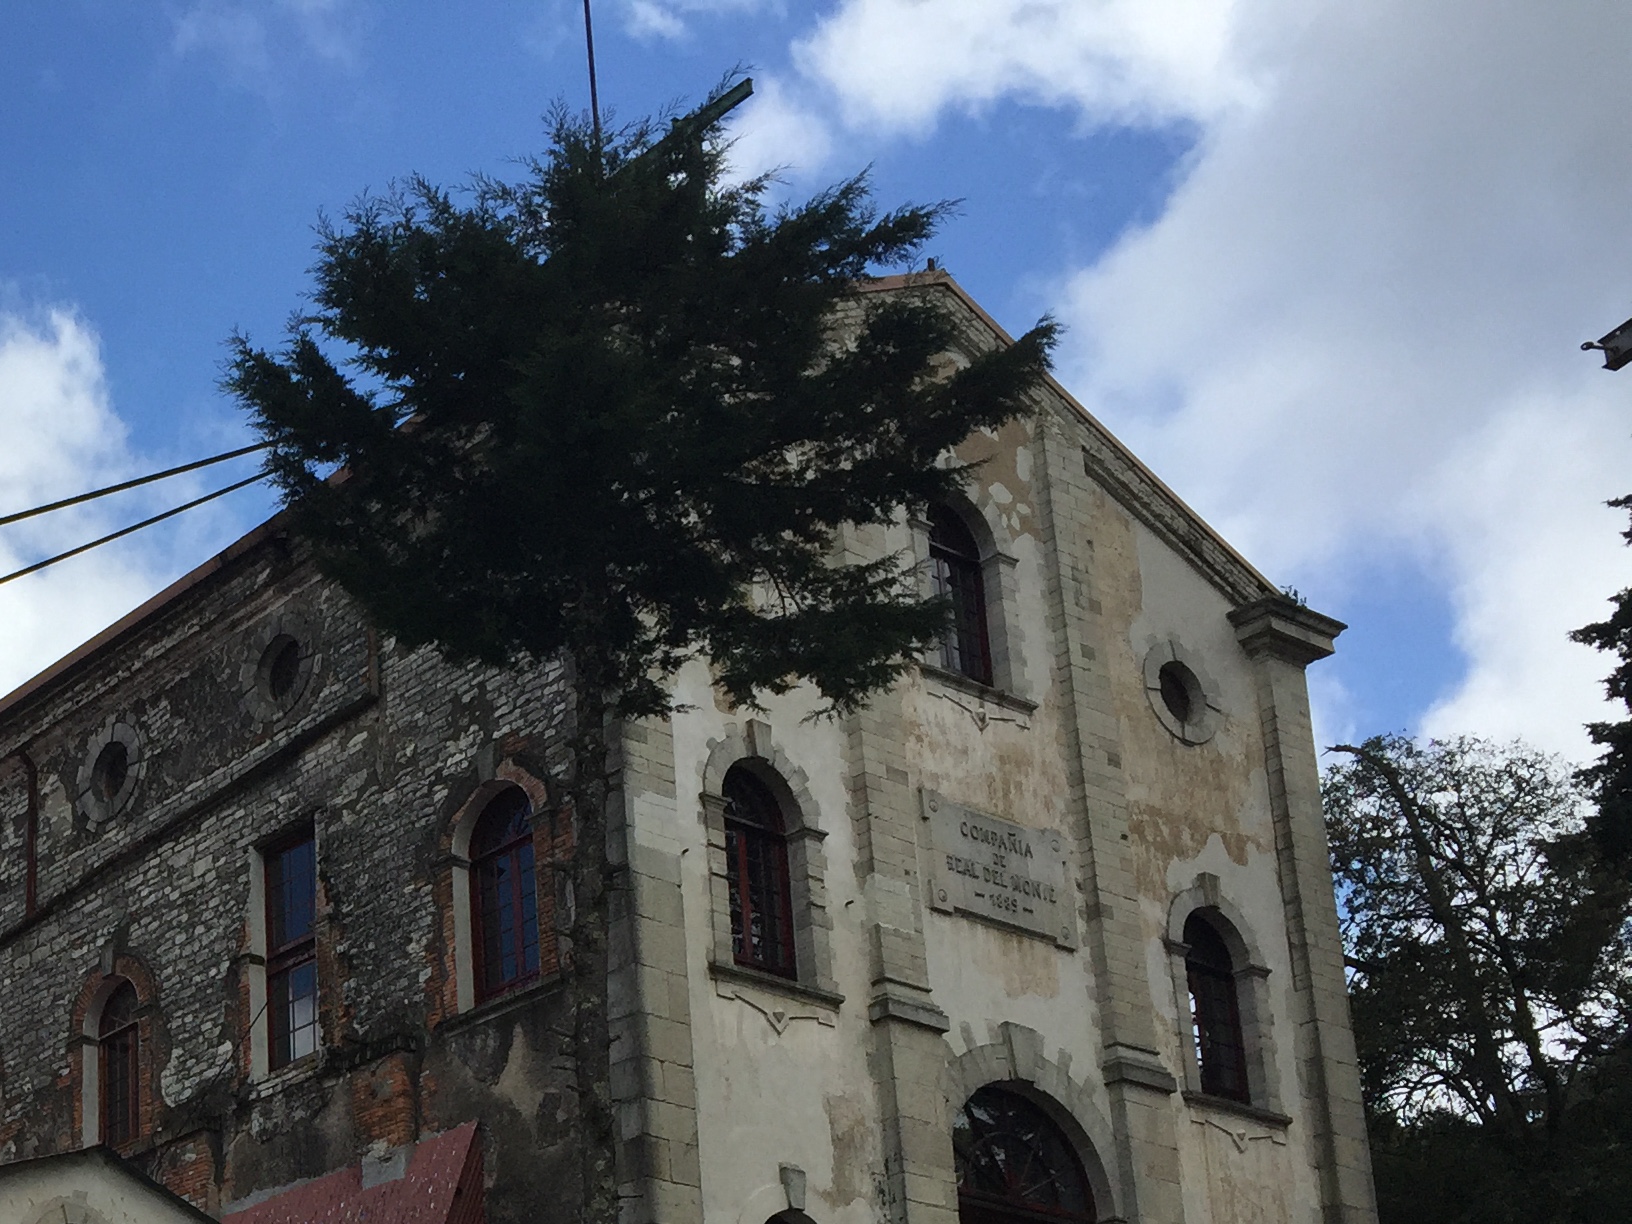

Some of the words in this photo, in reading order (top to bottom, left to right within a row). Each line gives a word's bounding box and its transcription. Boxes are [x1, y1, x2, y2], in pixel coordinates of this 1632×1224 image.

[992, 852, 1007, 869] DE
[946, 854, 980, 880] REAL
[982, 866, 1008, 889] DEL
[1010, 874, 1057, 905] MONTE
